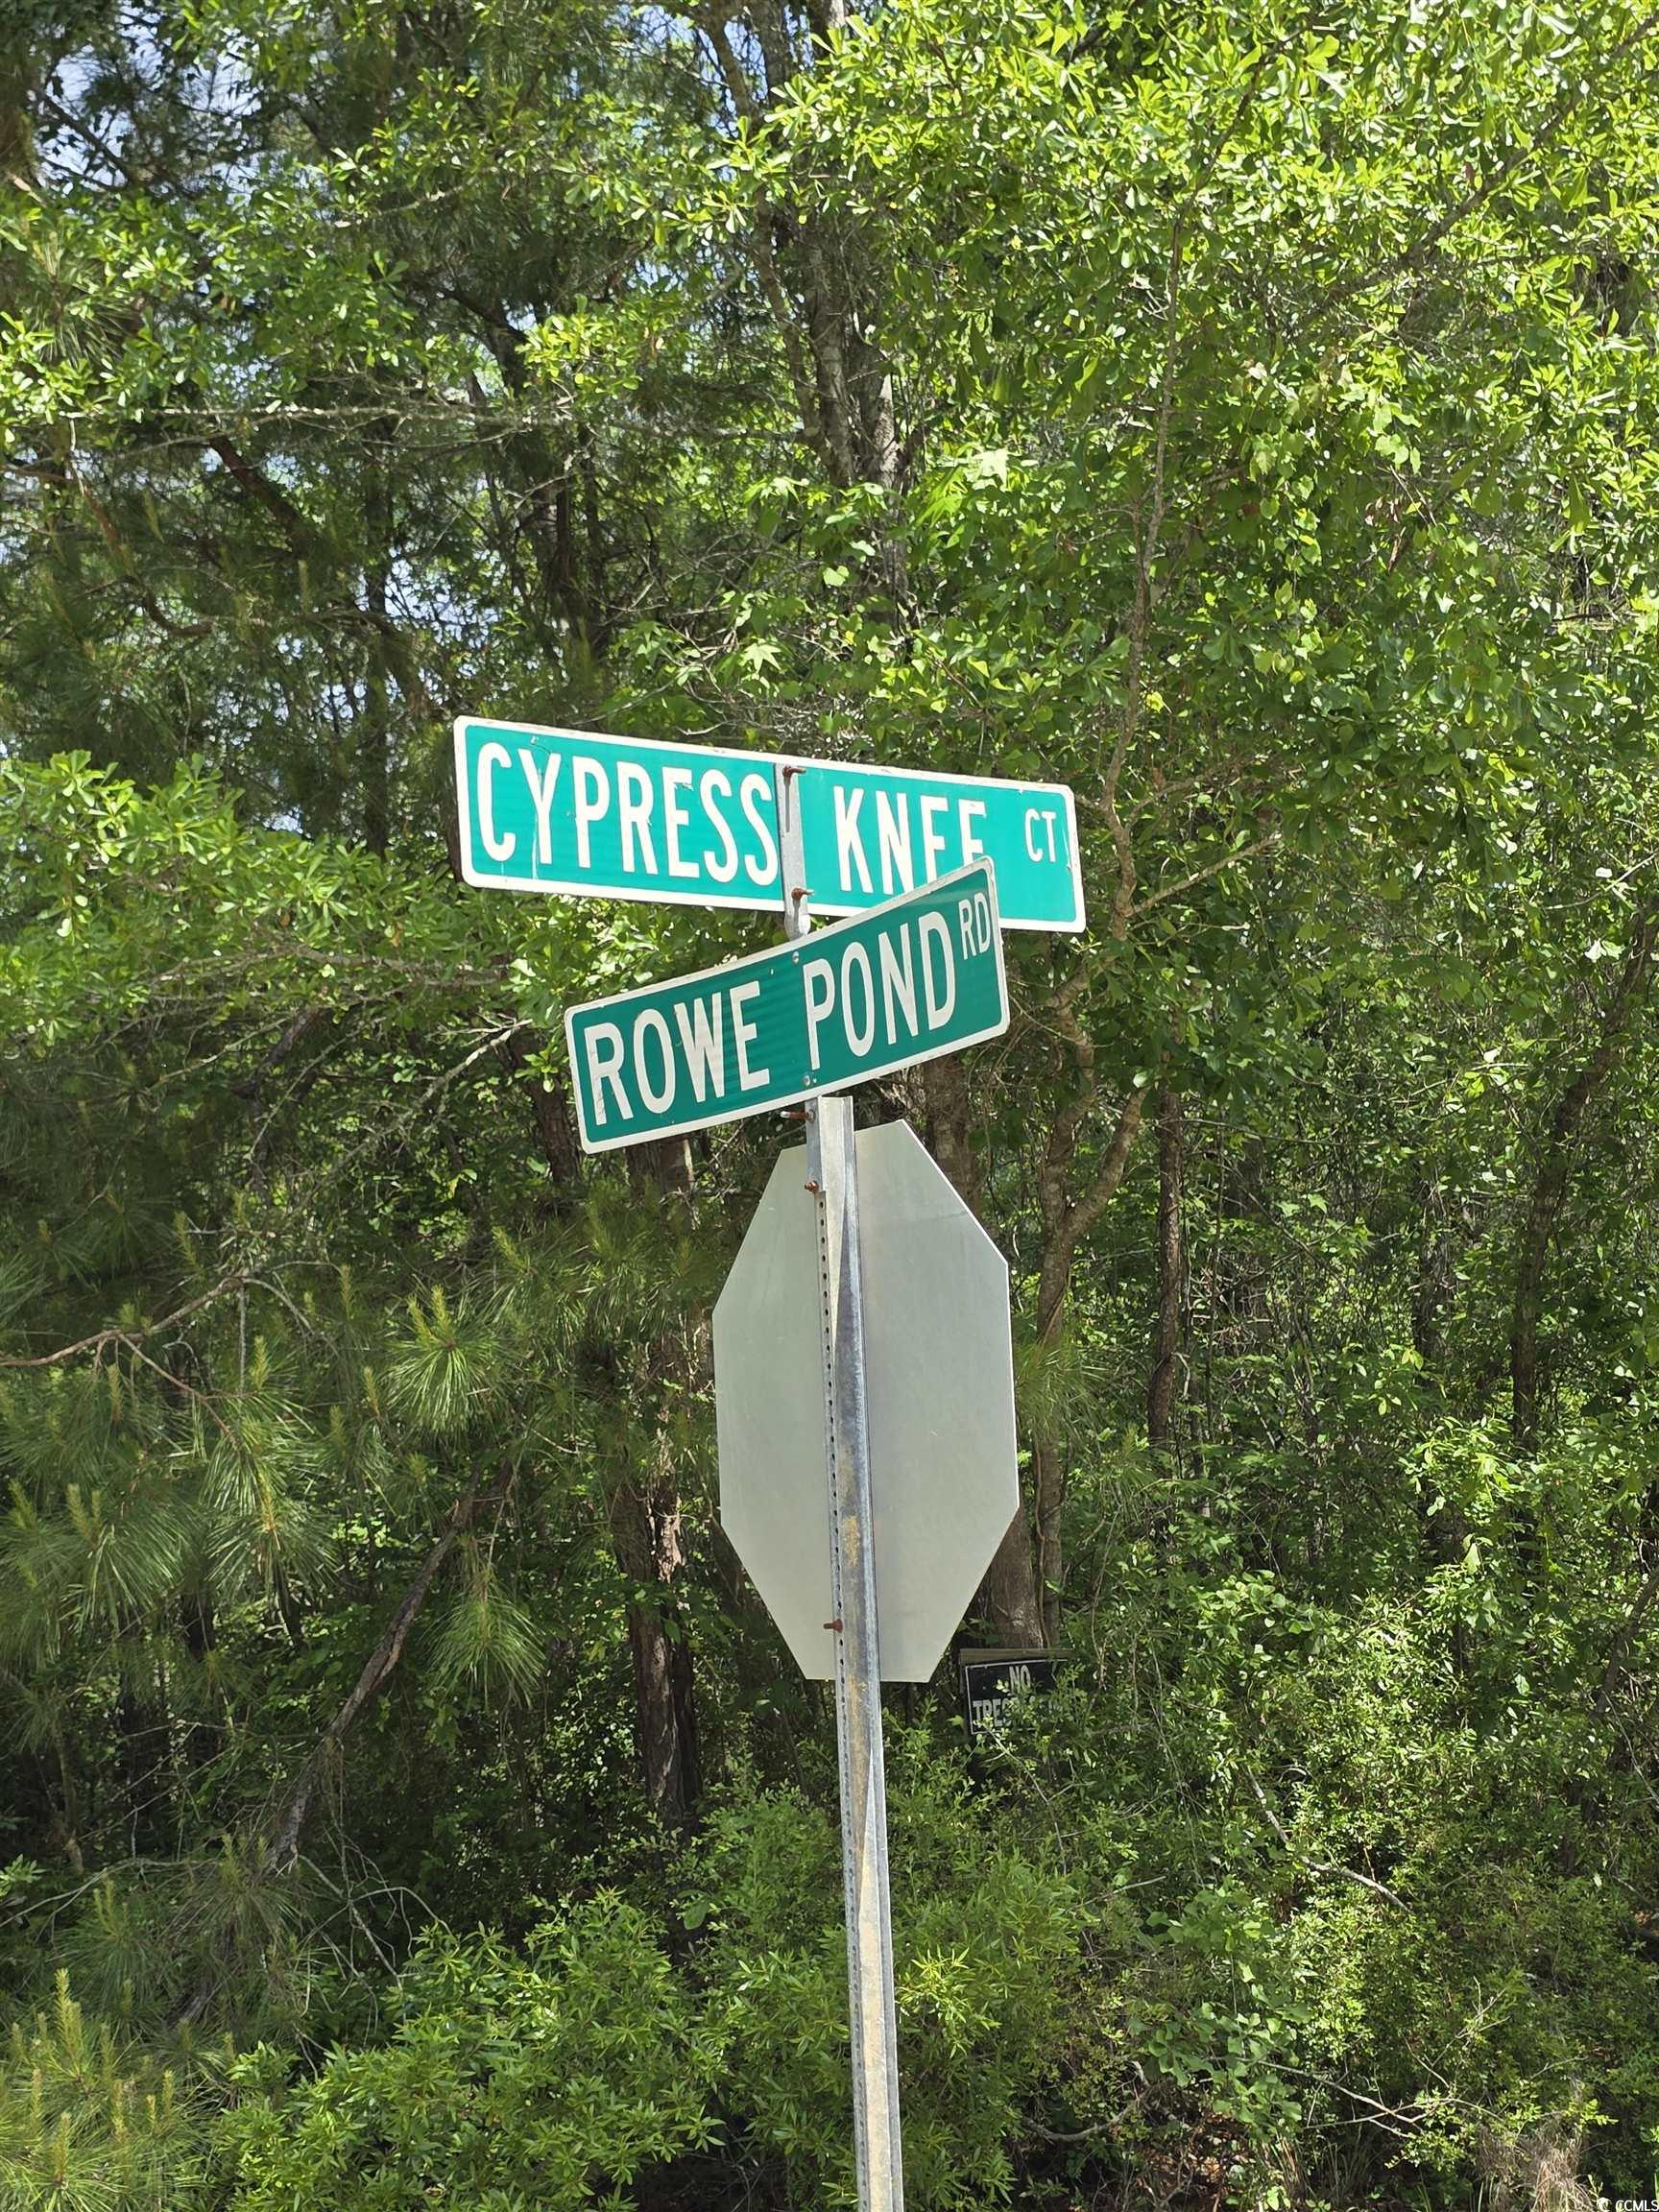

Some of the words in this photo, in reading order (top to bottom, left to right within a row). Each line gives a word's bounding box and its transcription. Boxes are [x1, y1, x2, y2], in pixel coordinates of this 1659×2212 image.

[477, 742, 778, 886] CYPRESS
[1024, 808, 1057, 863] CT
[584, 980, 769, 1125] ROWE
[803, 911, 955, 1070] POND
[958, 891, 992, 961] RD
[1008, 1664, 1032, 1694] NO
